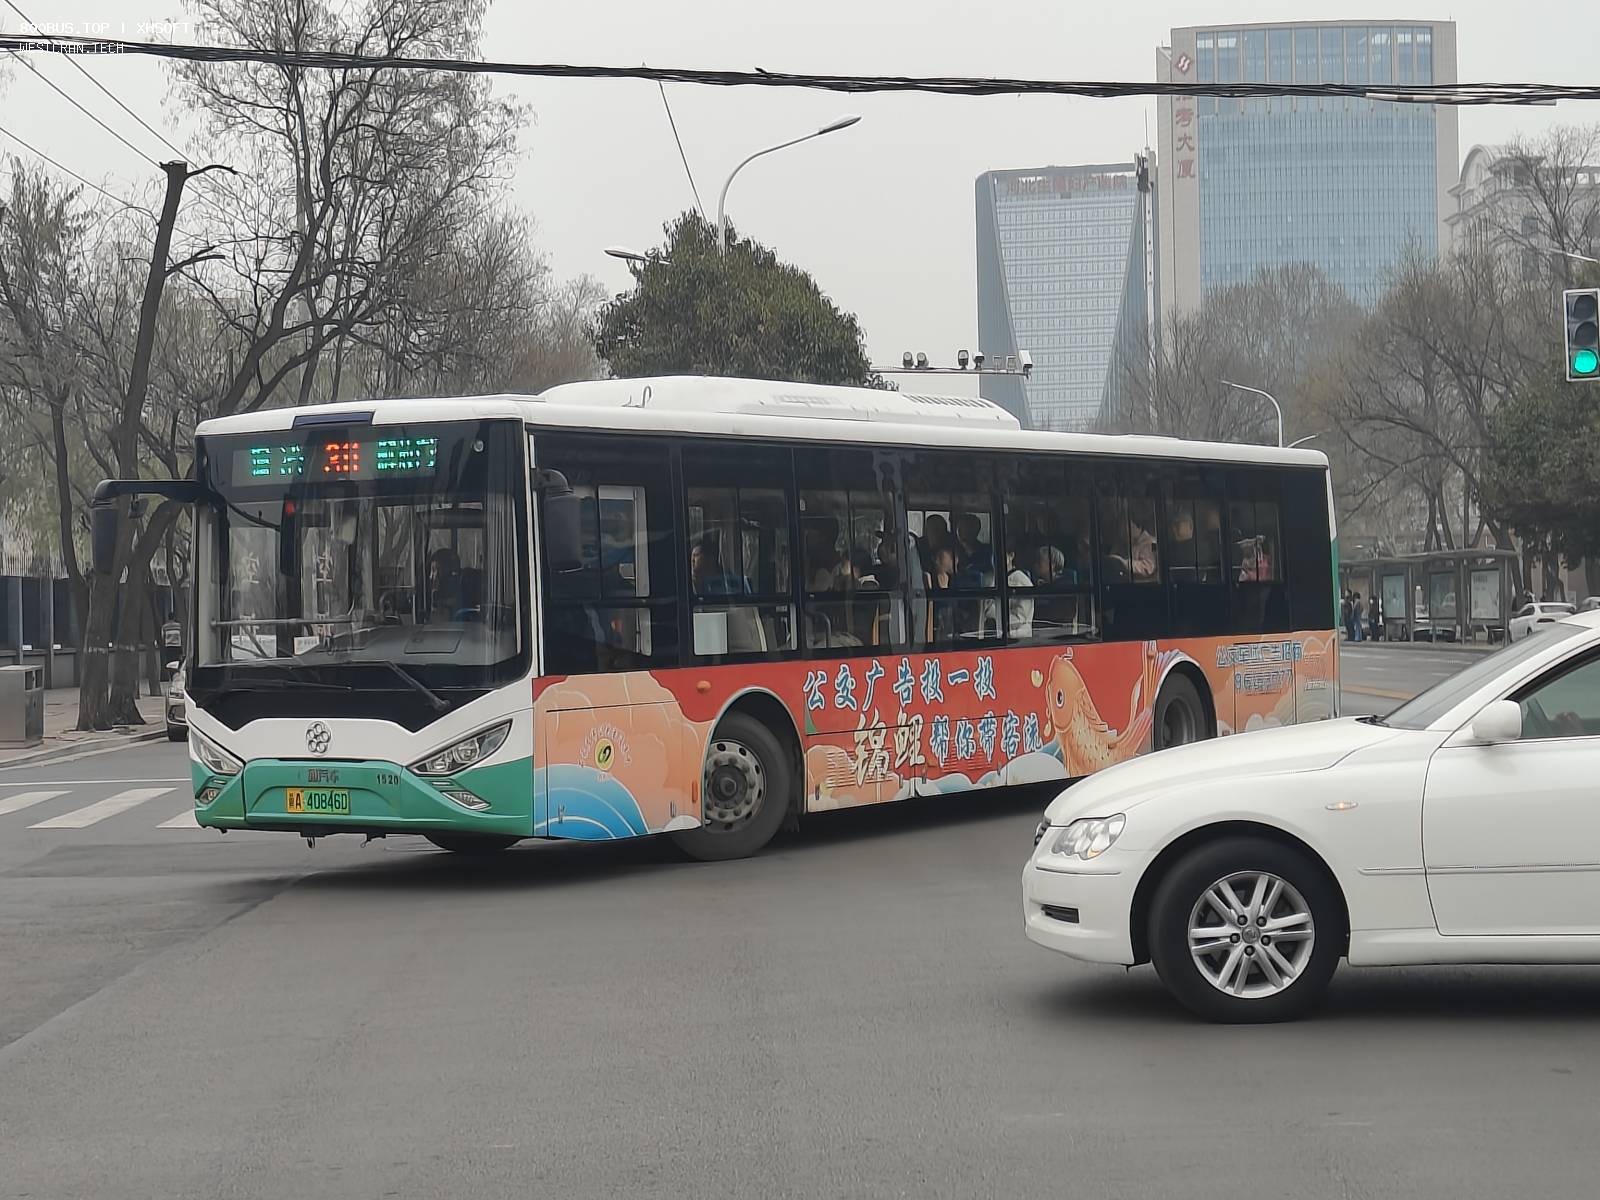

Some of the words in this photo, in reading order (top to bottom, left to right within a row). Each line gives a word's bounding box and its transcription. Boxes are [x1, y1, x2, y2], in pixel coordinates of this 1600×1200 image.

[803, 656, 996, 712] 公交广告投一投
[307, 792, 348, 810] 40846D
